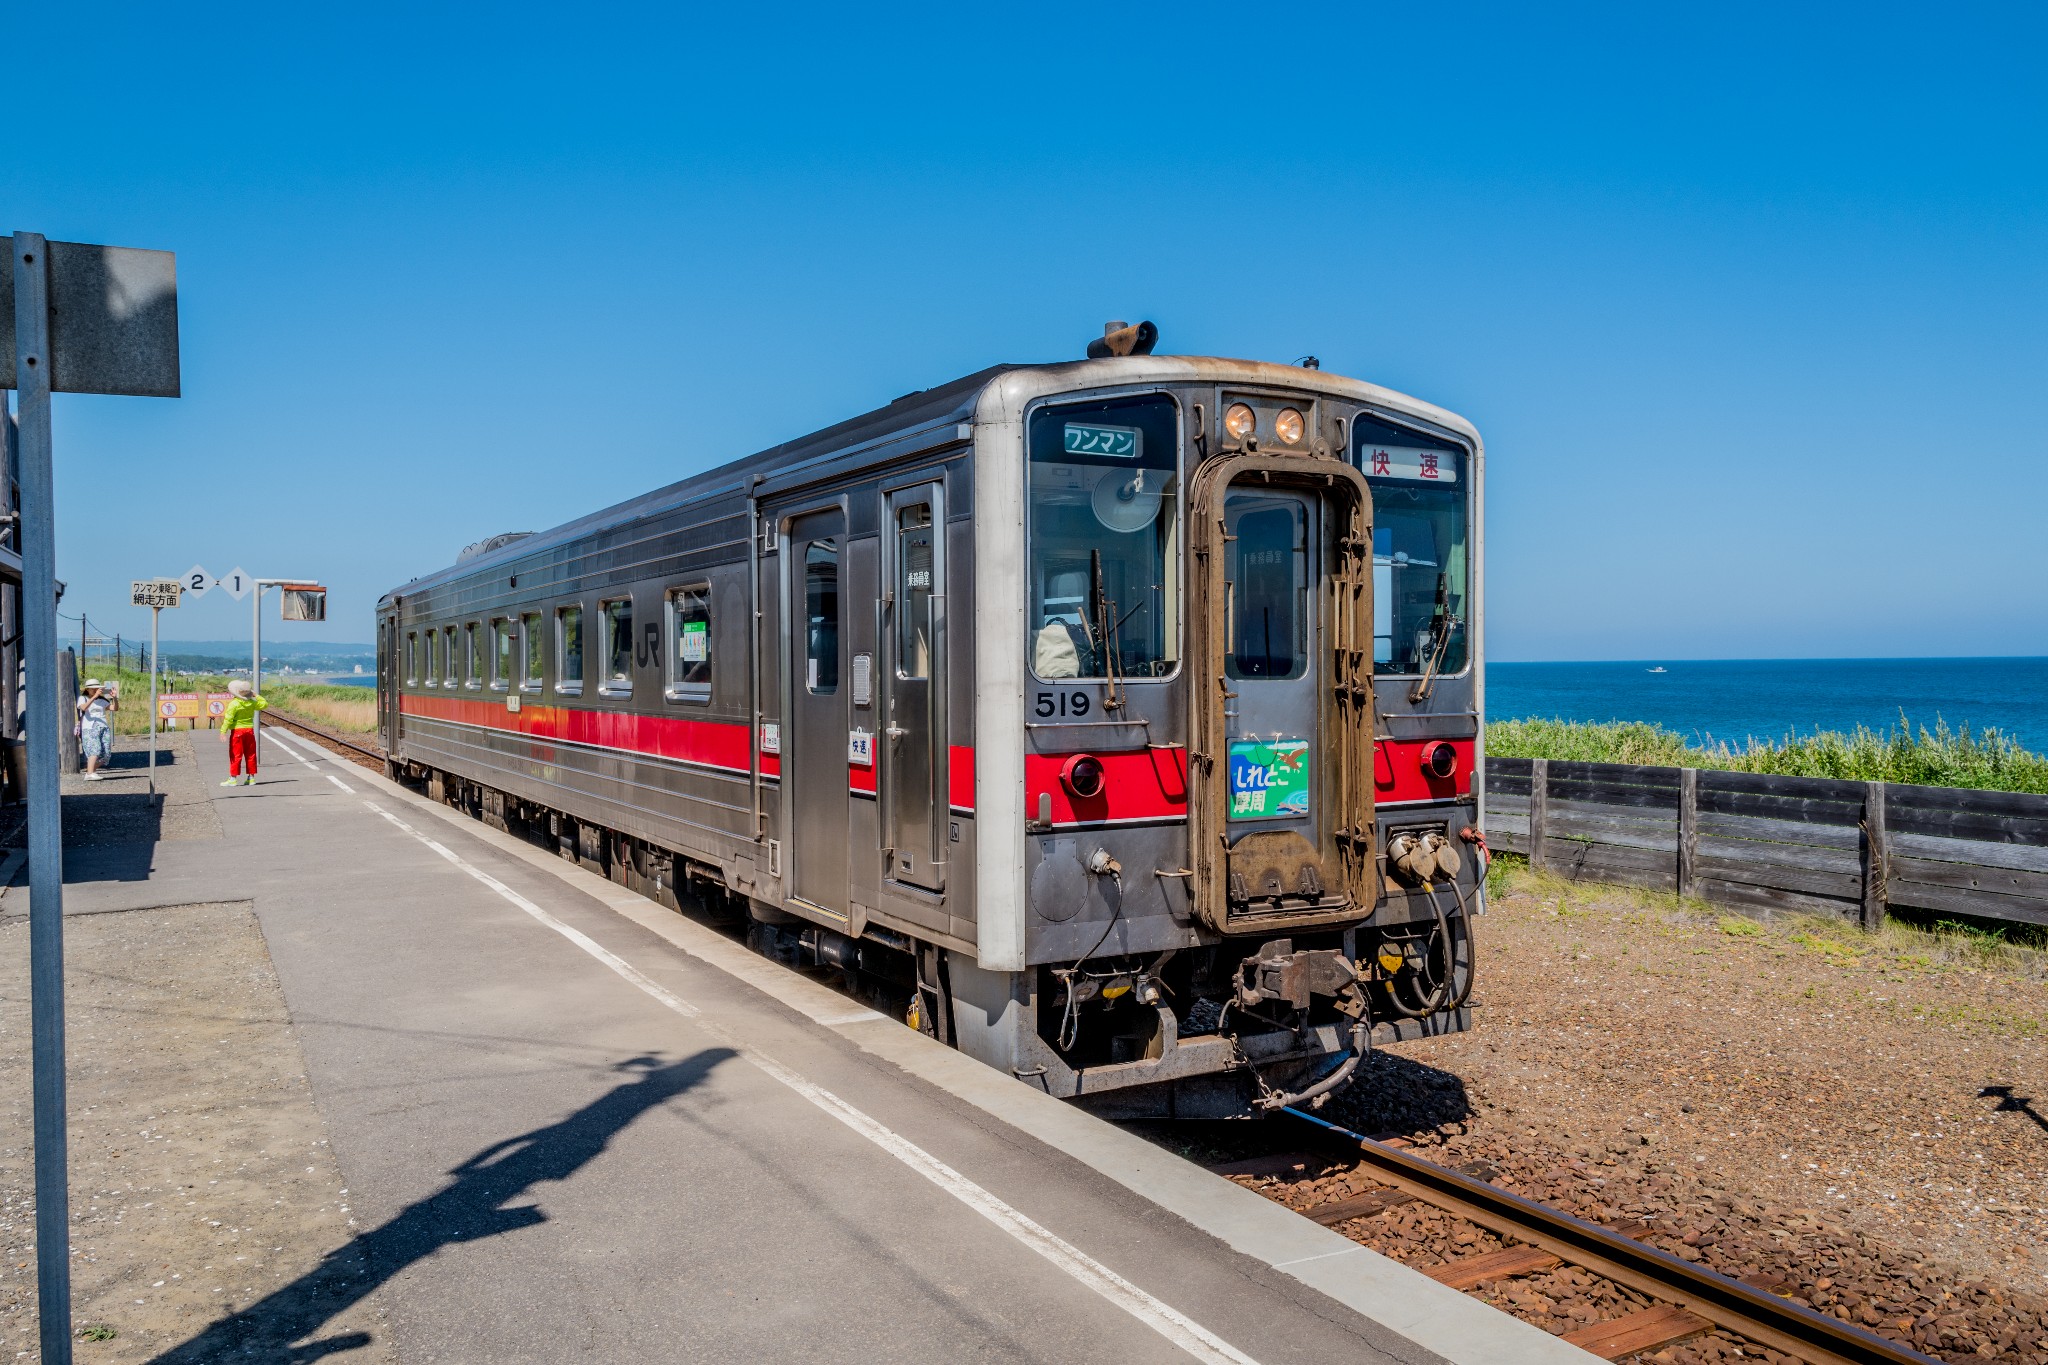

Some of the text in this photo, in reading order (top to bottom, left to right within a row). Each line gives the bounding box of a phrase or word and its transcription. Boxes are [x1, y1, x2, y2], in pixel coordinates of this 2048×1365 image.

[1064, 428, 1133, 453] ワンマン
[1371, 449, 1439, 478] 快速
[133, 583, 178, 594] ワンマン乗降口
[191, 574, 204, 590] 2
[234, 576, 241, 592] 1
[907, 571, 930, 587] 乗務員室
[133, 593, 178, 606] 網走方面
[636, 622, 660, 668] JR
[1035, 691, 1090, 718] 519
[1236, 764, 1291, 788] しれとこ
[1233, 790, 1266, 813] 摩周
